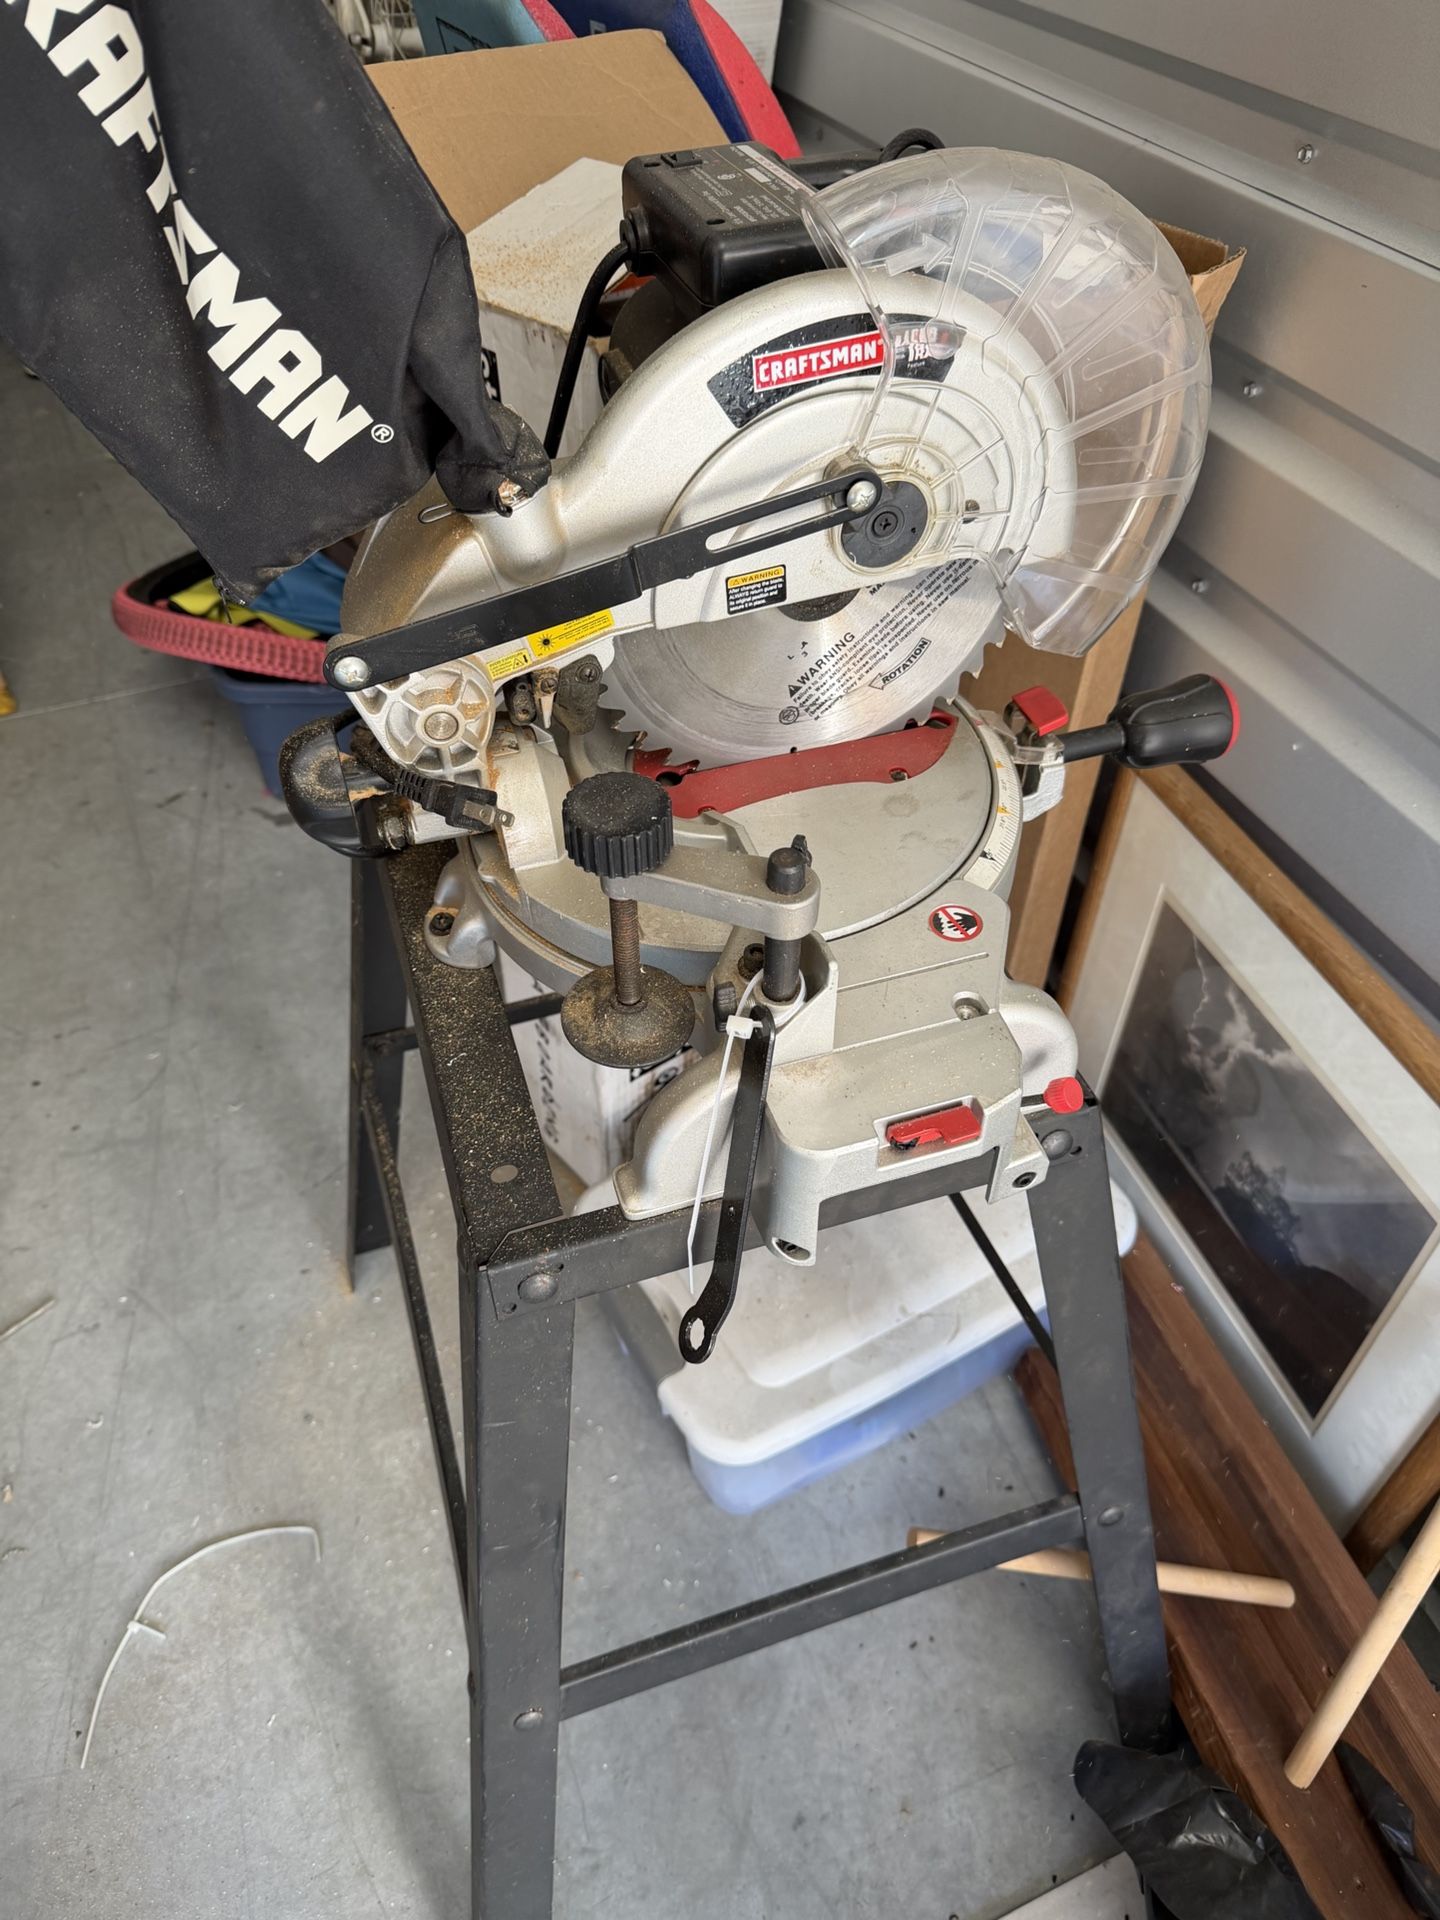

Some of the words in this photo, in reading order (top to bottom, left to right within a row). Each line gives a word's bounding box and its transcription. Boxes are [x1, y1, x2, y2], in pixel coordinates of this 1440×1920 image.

[729, 592, 749, 600] ALWAYS
[764, 585, 777, 593] guard
[736, 596, 751, 605] original
[741, 570, 779, 582] WARNING
[741, 583, 761, 592] changing
[793, 685, 811, 702] Failure
[817, 667, 831, 680] obey
[831, 652, 848, 668] safety
[847, 622, 879, 652] instructions
[879, 612, 890, 623] and
[890, 589, 915, 613] warnings
[915, 578, 926, 589] can
[803, 695, 821, 712] proper
[820, 681, 835, 696] blade
[852, 645, 874, 666] Examine
[874, 631, 890, 646] blade
[889, 614, 908, 631] before
[925, 583, 941, 599] Never
[942, 573, 953, 583] use
[815, 679, 828, 692] Wear
[868, 633, 878, 643] eye
[907, 590, 923, 606] Never
[923, 570, 945, 592] operate
[945, 560, 956, 571] saw
[842, 679, 858, 694] Obey
[864, 651, 888, 674] warnings
[888, 641, 899, 651] and
[899, 612, 930, 642] instructions
[938, 595, 949, 606] saw
[854, 660, 869, 674] loose
[868, 648, 882, 661] tips)
[916, 601, 932, 616] Never
[933, 591, 944, 601] use
[944, 584, 952, 592] on
[951, 564, 972, 584] ferrous
[797, 631, 856, 685] WARNING
[881, 640, 928, 684] ROTATION
